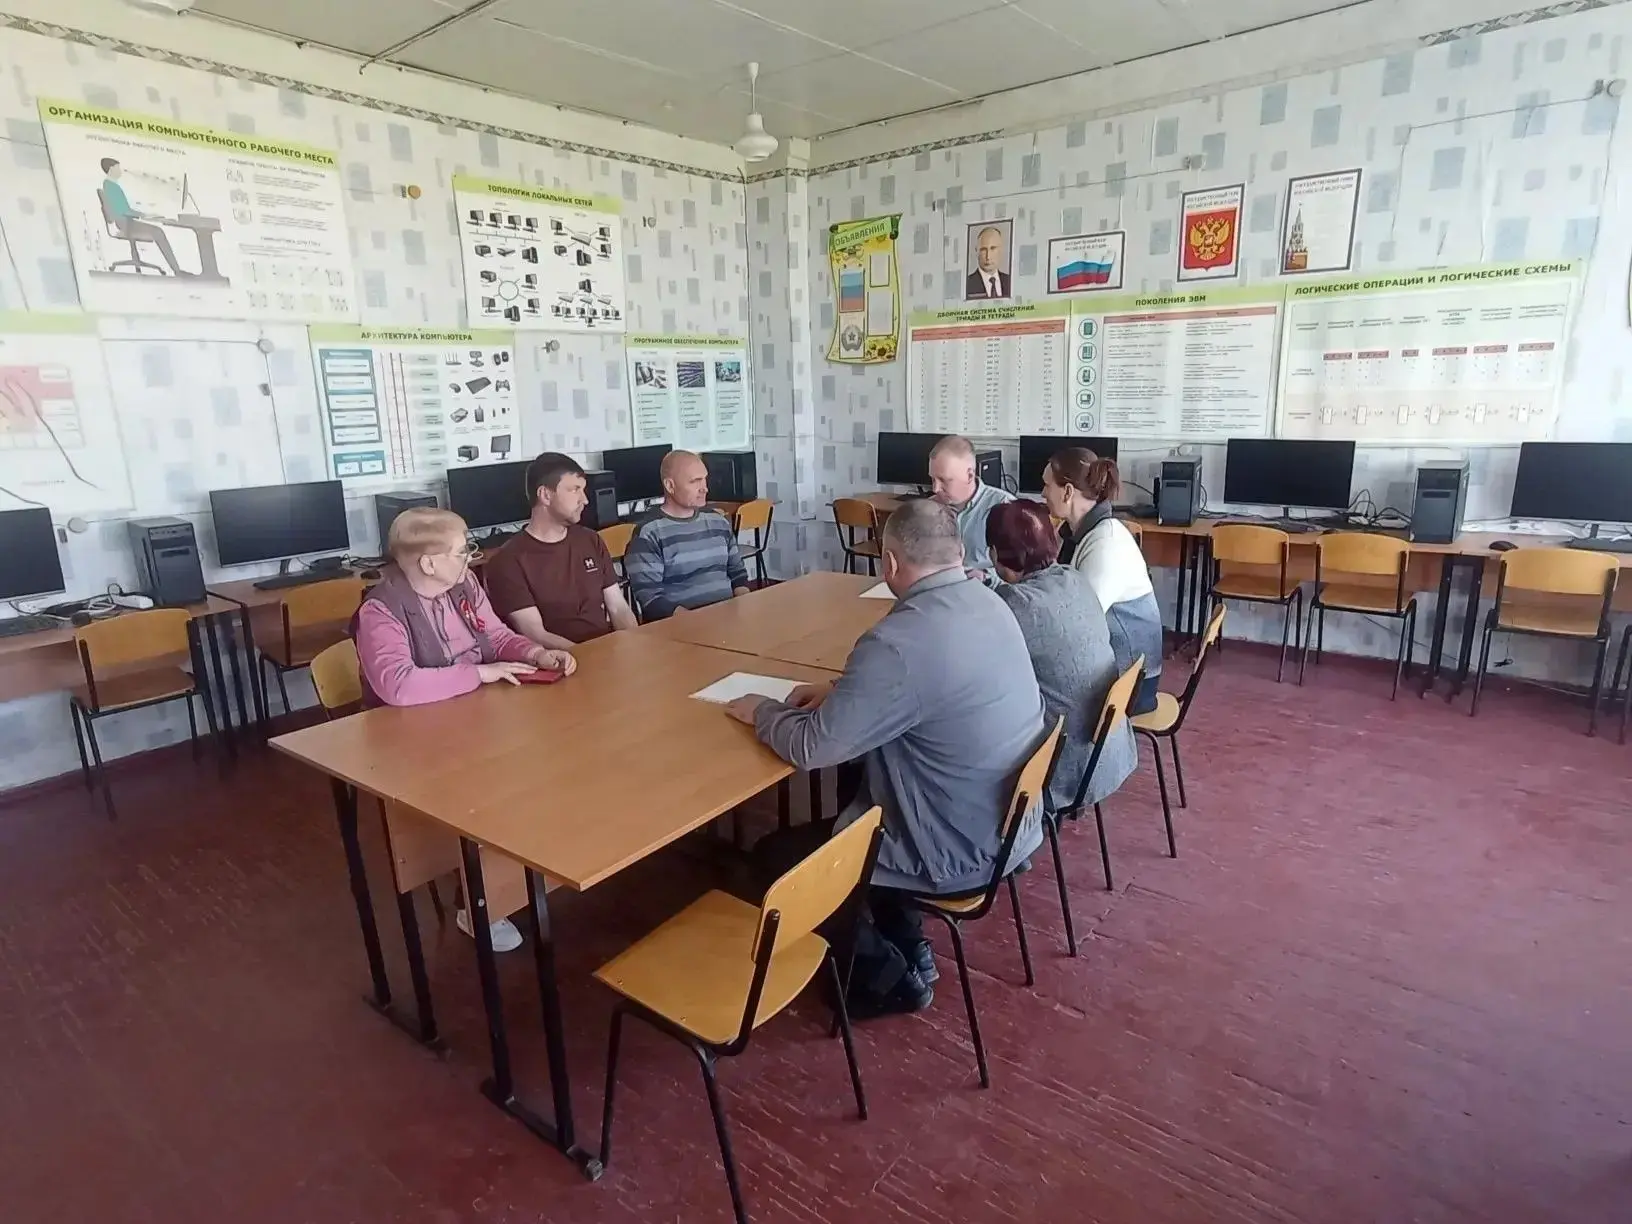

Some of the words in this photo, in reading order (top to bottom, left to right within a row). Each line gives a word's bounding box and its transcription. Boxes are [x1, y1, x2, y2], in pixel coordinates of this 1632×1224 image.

[48, 106, 143, 129] ОРГАНИЗАЦИЯ
[148, 123, 247, 150] КОМПЬЮТЕРНОГО
[250, 143, 301, 160] РАБОЧЕГО
[304, 153, 335, 167] МЕСТА
[488, 184, 530, 197] ТОПОЛОГИИ
[532, 192, 573, 204] ЛОКАЛЬНЫХ
[575, 198, 593, 207] СЕТЕЙ
[835, 223, 885, 246] ОБЪЯВЛЕНИЯ
[1295, 282, 1359, 295] ЛОГИЧЕСКИЕ
[1363, 276, 1424, 289] ОПЕРАЦИИ
[1428, 275, 1436, 284] И
[1440, 267, 1520, 283] ЛОГИЧЕСКИЕ
[1525, 264, 1571, 275] СХЕМЫ
[970, 308, 996, 316] СИСТЕМА
[1135, 296, 1186, 306] ПОКОЛЕНИЯ
[361, 332, 418, 340] АРХИТЕКТУРА
[420, 332, 473, 341] КОМПЬЮТЕРА
